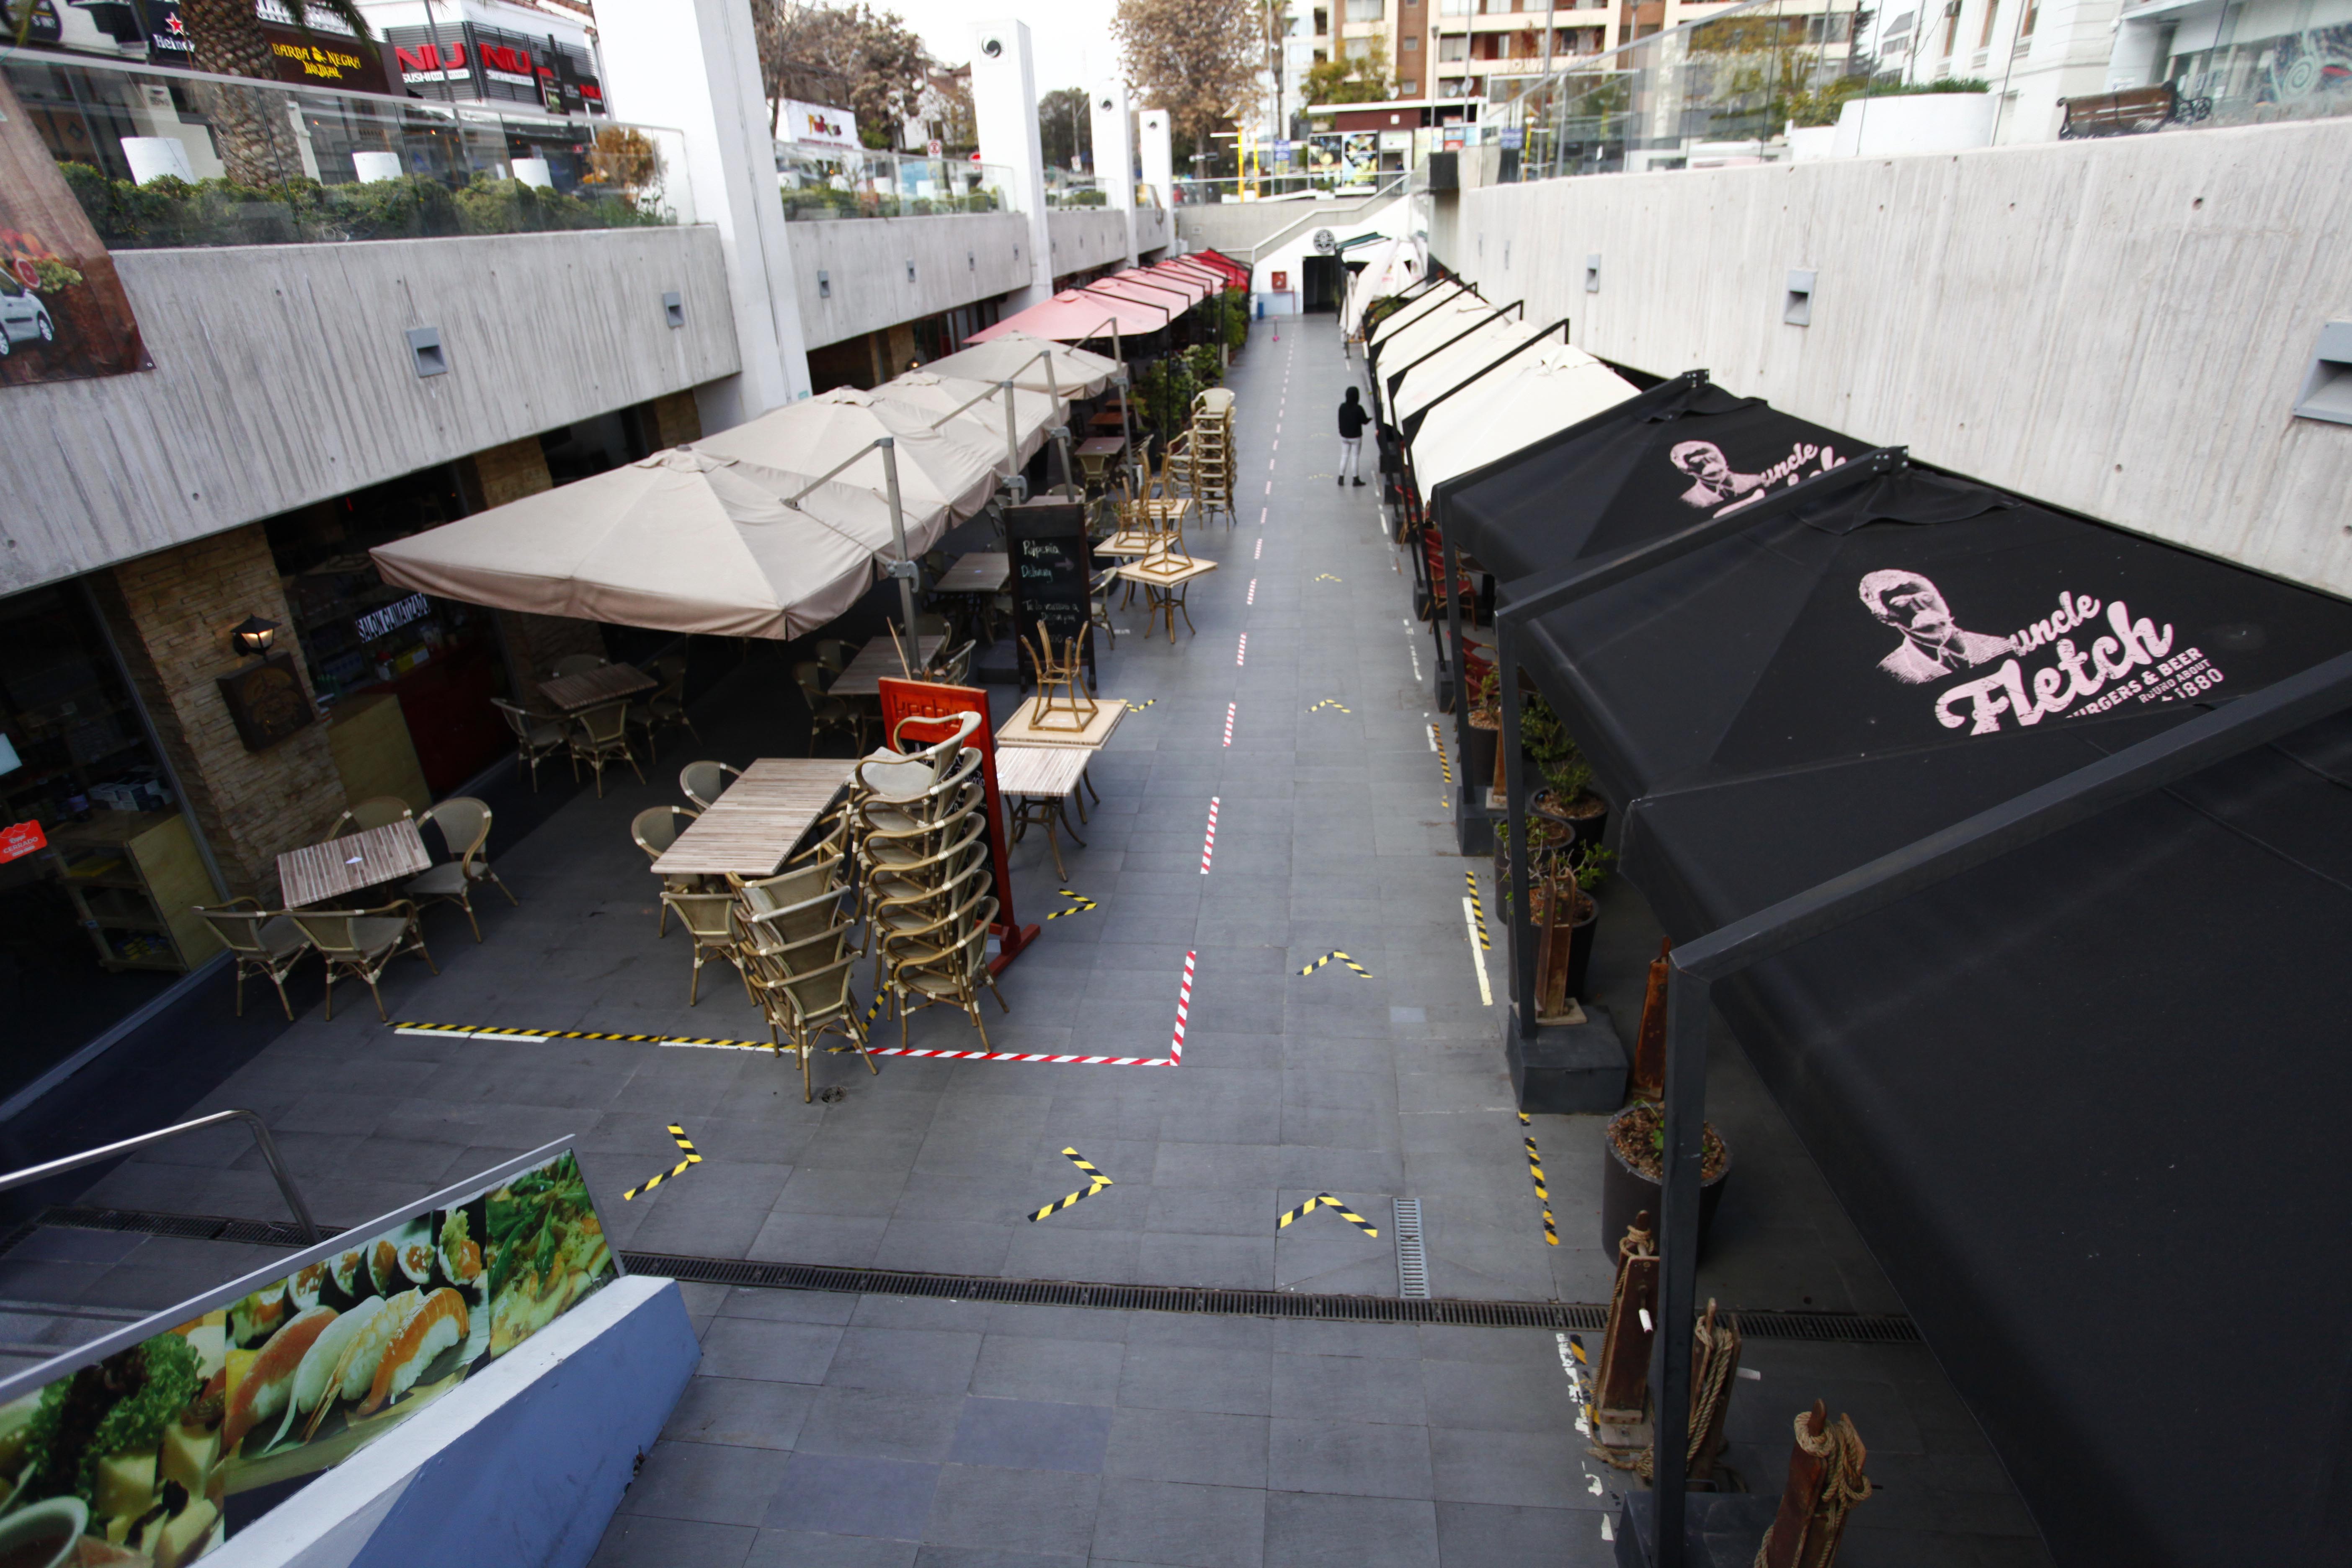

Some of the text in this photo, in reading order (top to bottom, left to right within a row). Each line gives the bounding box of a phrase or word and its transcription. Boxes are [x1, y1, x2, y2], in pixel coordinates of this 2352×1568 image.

[272, 43, 361, 70] BARBA NEGRA
[395, 41, 467, 74] NIU
[480, 42, 532, 75] NIU
[402, 72, 431, 84] SUSHI
[1760, 442, 1818, 487] uncle
[358, 593, 431, 642] SALON CLIMATIZADO
[2009, 591, 2101, 657] uncle
[1935, 601, 2174, 736] Fletch
[2156, 647, 2204, 677] BEER
[2176, 659, 2211, 682] ABOUT
[2174, 668, 2224, 699] 1880
[3, 836, 39, 854] CERRADO
